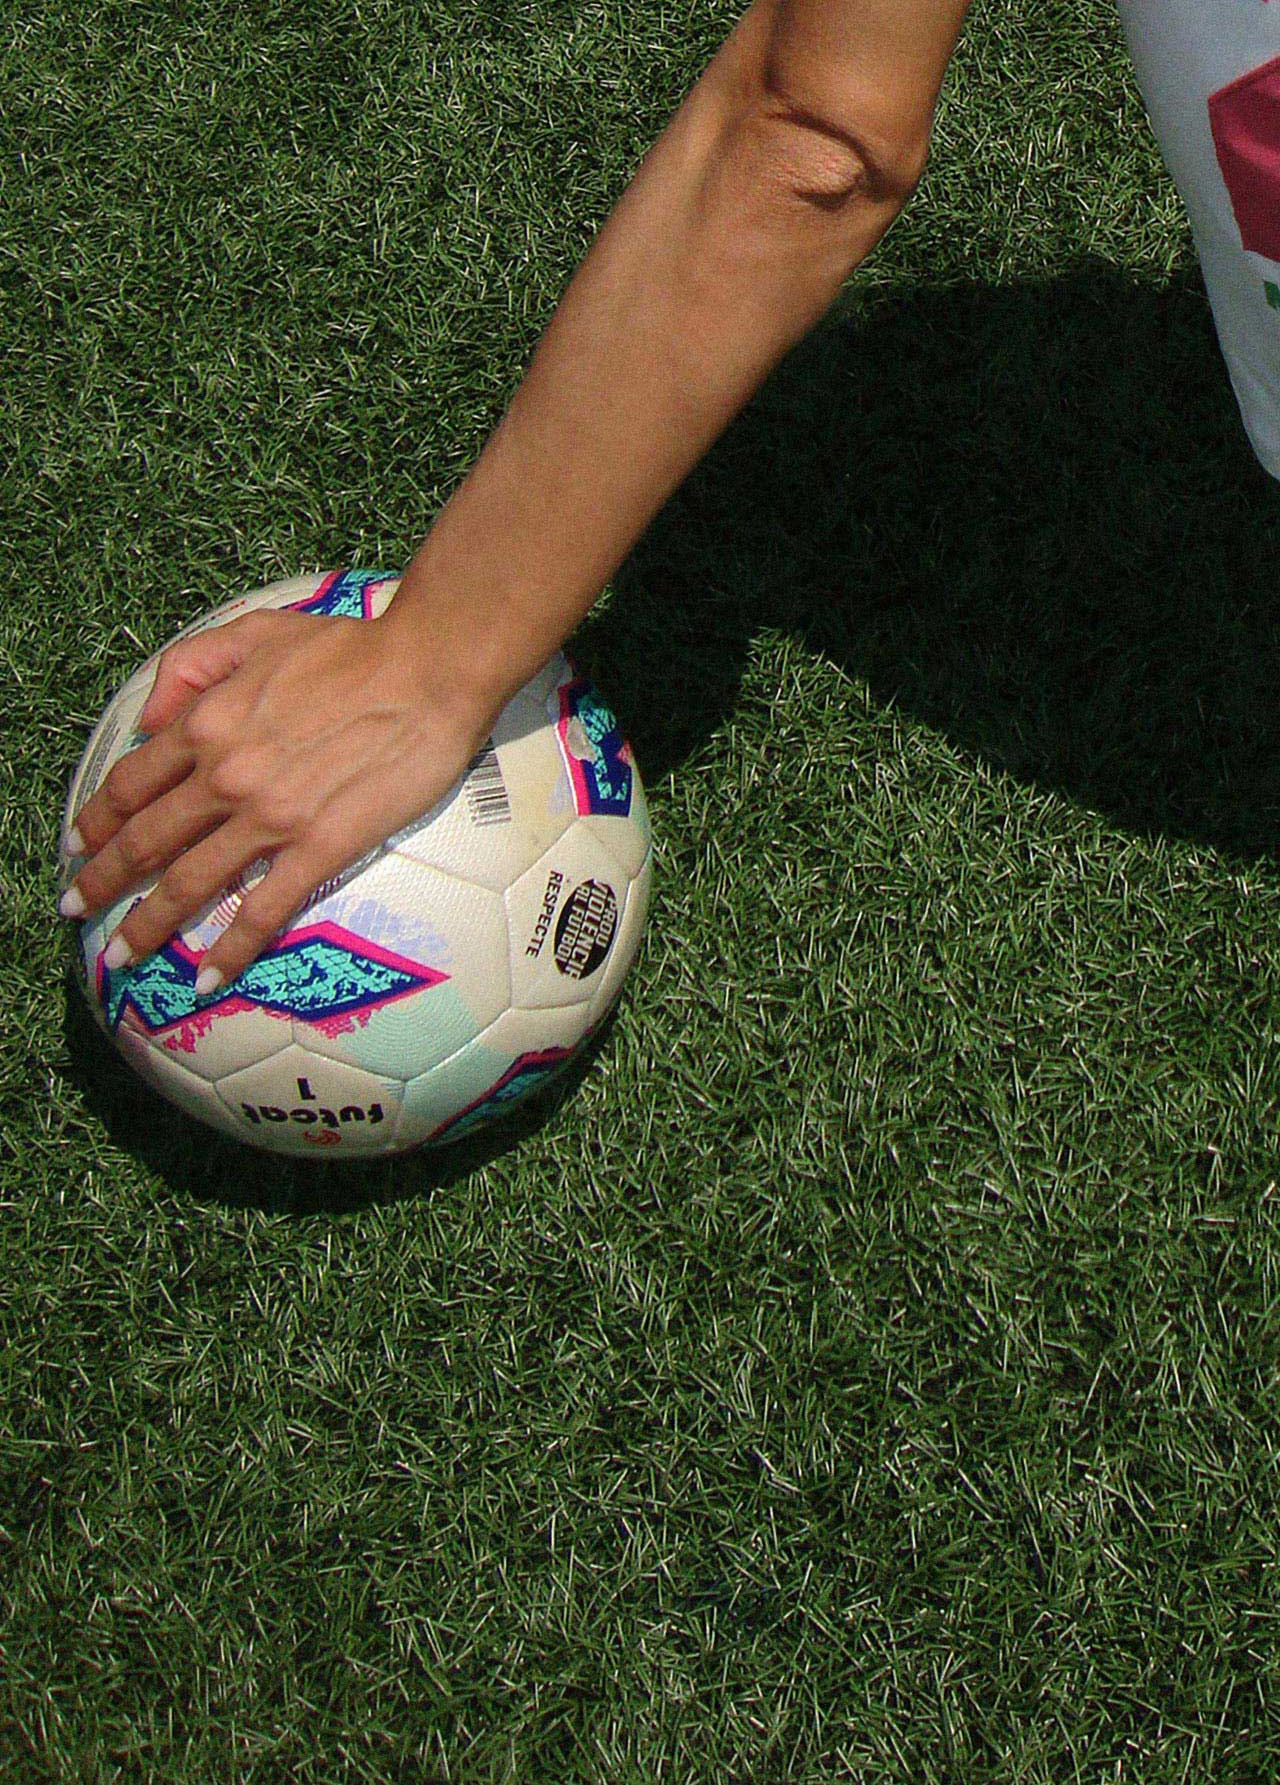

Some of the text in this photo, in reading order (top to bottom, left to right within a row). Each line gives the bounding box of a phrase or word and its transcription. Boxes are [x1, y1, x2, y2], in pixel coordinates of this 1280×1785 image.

[525, 869, 563, 959] RESPECTE
[595, 896, 617, 948] PROU
[297, 1077, 316, 1100] 1
[241, 1102, 384, 1128] futcat
